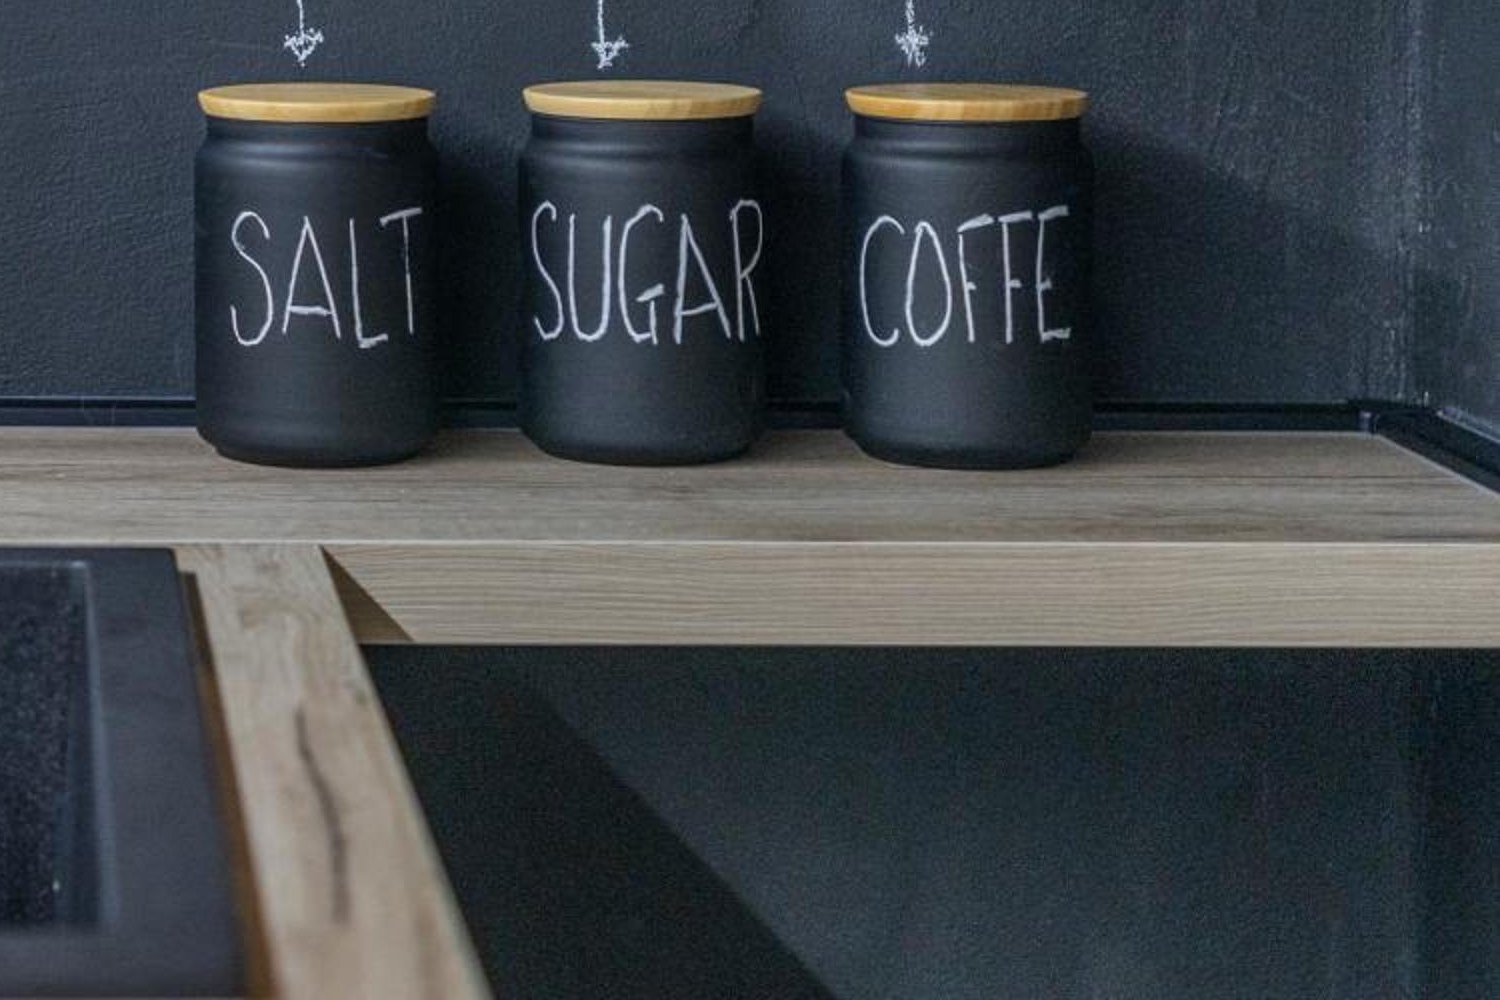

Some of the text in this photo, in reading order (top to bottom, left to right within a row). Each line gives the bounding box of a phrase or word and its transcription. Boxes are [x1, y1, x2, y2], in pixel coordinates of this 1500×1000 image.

[231, 208, 422, 348] SALT
[532, 199, 762, 344] SUGAR
[860, 206, 1070, 347] COFFE
